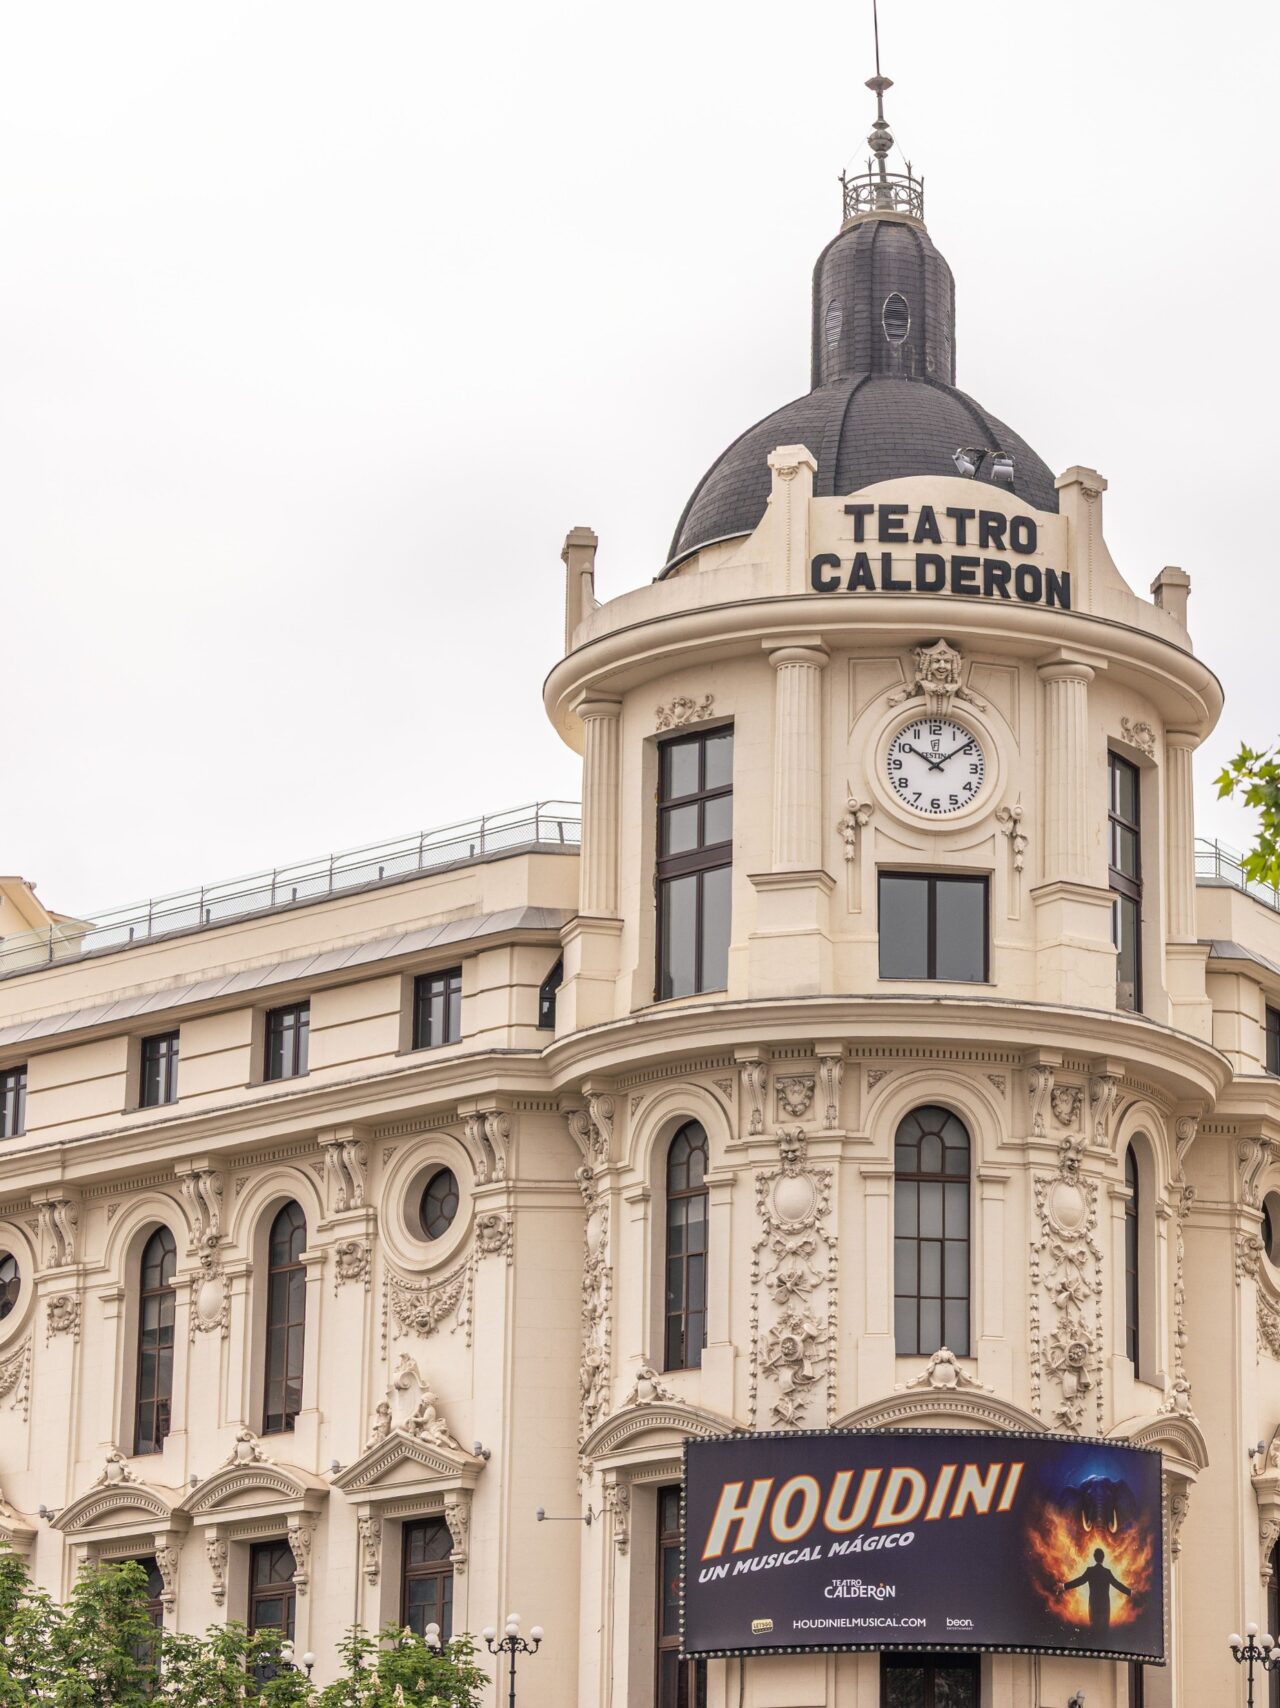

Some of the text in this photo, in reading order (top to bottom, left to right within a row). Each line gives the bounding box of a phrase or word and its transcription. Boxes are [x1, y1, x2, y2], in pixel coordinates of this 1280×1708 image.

[844, 504, 1037, 554] TEATRO
[811, 552, 1071, 610] CALDERON
[929, 725, 942, 736] 12
[898, 742, 913, 754] 10
[963, 744, 973, 756] 2
[893, 759, 902, 769] 9
[969, 764, 978, 774] 3
[899, 778, 908, 788] 8
[962, 781, 973, 792] 4
[913, 792, 922, 803] 7
[949, 795, 958, 805] 5
[931, 799, 940, 809] 6
[700, 1462, 1025, 1562] HOUDINI
[698, 1531, 915, 1583] UN MUSICAL MÁGICO
[831, 1579, 862, 1588] TEATRO
[793, 1618, 927, 1629] HOUDINIELMUSICAL.COM
